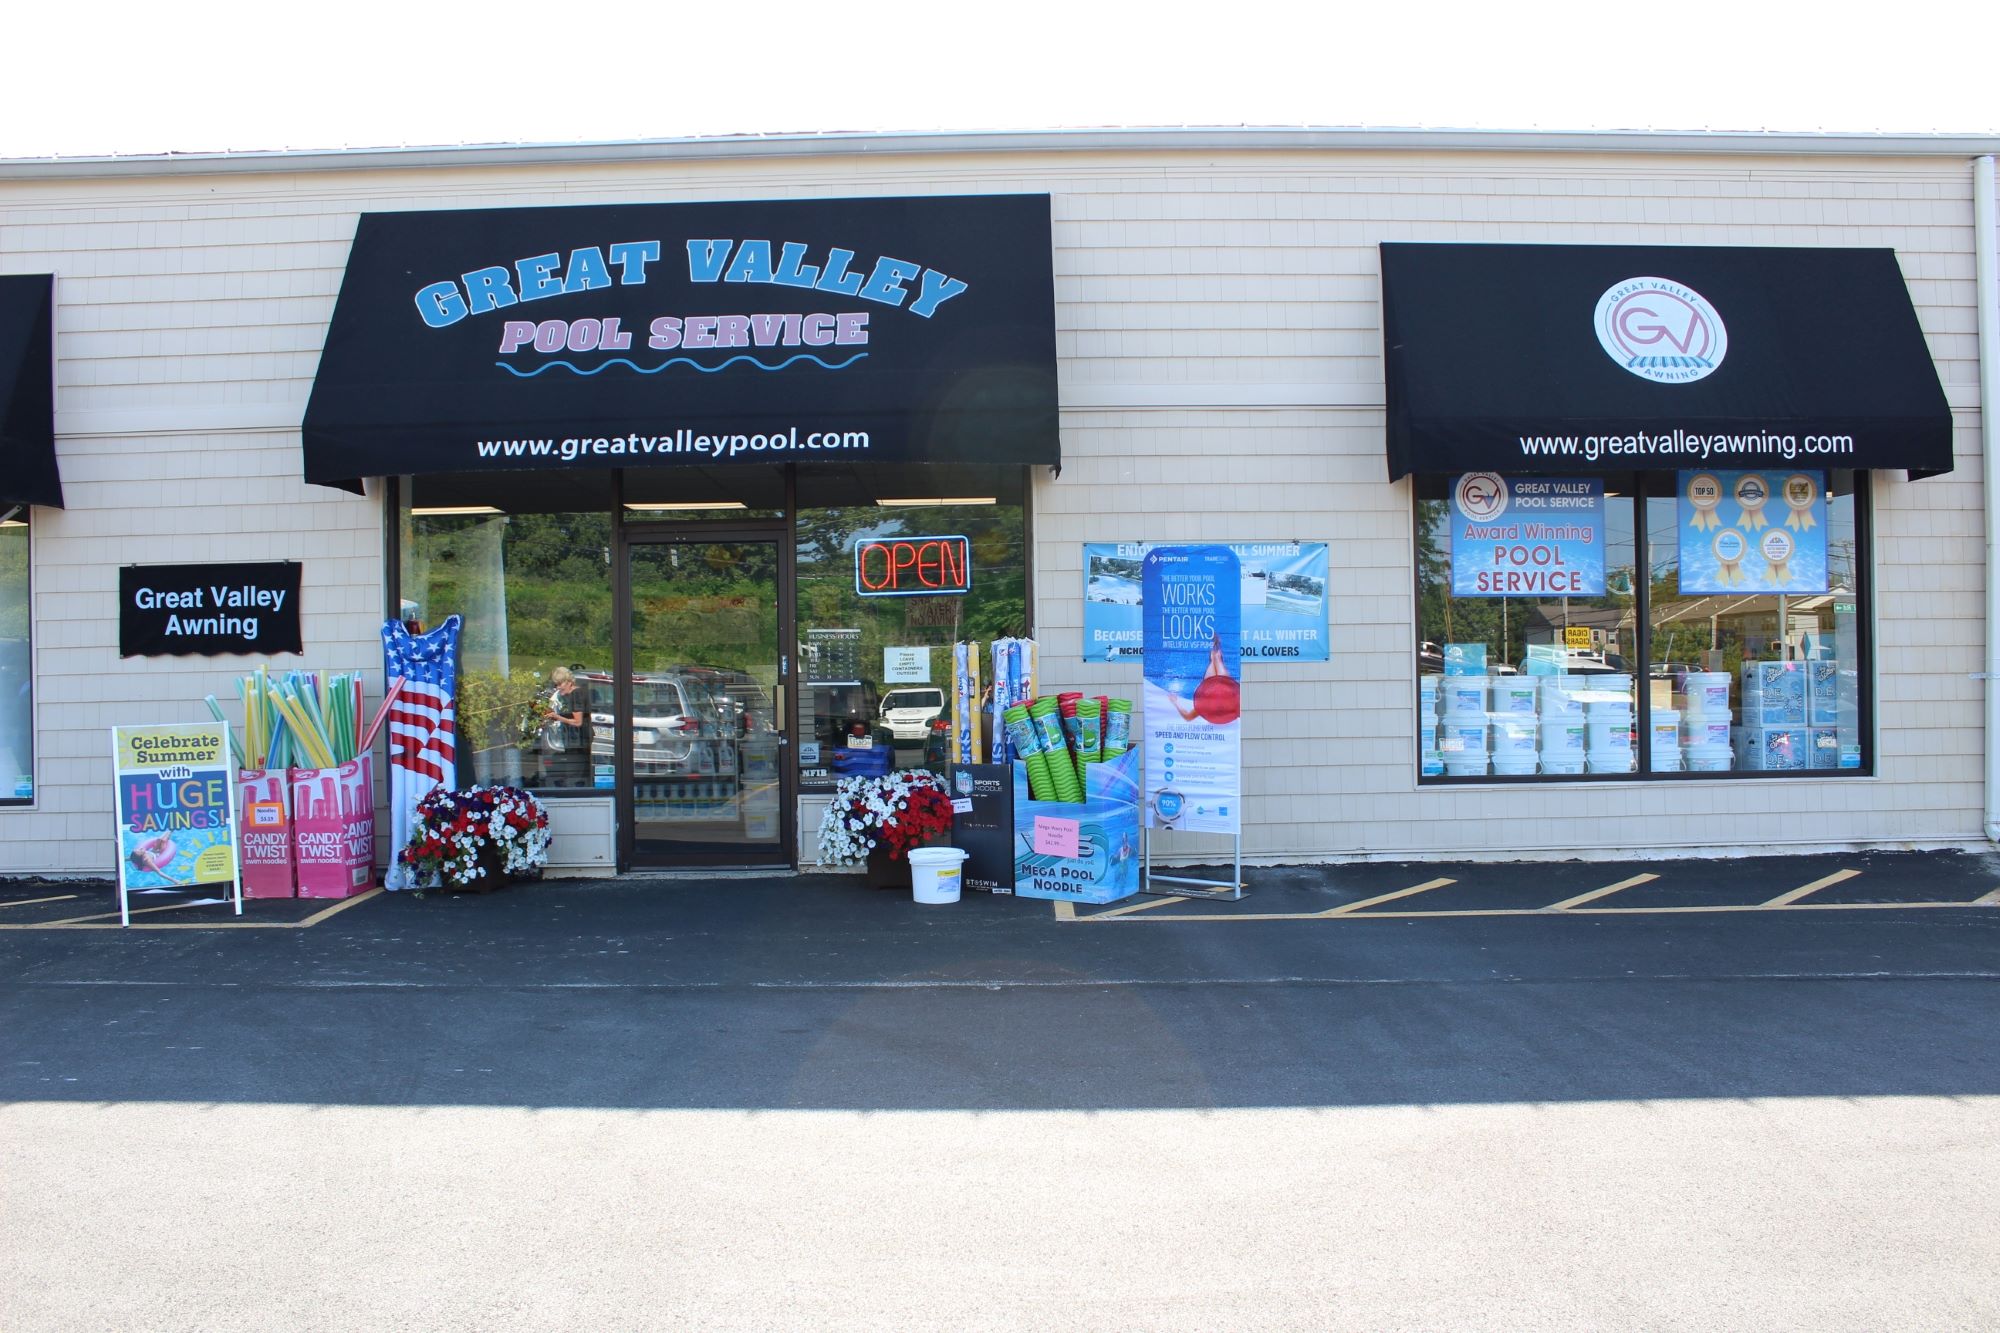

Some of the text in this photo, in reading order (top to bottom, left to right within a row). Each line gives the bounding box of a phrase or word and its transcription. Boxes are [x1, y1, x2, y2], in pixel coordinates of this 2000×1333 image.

[415, 239, 968, 328] GREAT VALLEY
[1611, 282, 1697, 303] GREAT VALLEY
[499, 312, 869, 353] POOL SERVICE
[1644, 368, 1699, 380] AWNING
[476, 427, 870, 461] www.greatvalleypool.com
[1520, 429, 1854, 460] www.greatvalleyawning.com
[1515, 483, 1591, 494] GREAT VALLEY
[1695, 487, 1706, 495] TOP
[1515, 497, 1594, 508] POOL SERVICE
[1464, 523, 1593, 544] Award Winning
[1251, 544, 1300, 557] SUMMER
[1494, 545, 1565, 566] POOL
[861, 541, 965, 590] OPEN
[1477, 571, 1581, 592] SERVICE
[135, 586, 286, 613] Great Valley
[1161, 583, 1215, 606] WORKS
[164, 614, 258, 640] Awning
[1162, 614, 1215, 640] LOOKS
[1094, 629, 1143, 642] BECAUSE
[1253, 630, 1271, 641] ALL
[1275, 630, 1318, 641] WINTER
[1262, 645, 1299, 657] COVERS
[131, 734, 220, 750] Celebrate
[1155, 731, 1172, 739] SPEED
[1201, 733, 1226, 741] CONTROL
[136, 750, 216, 763] Summer
[160, 766, 191, 779] with
[802, 768, 827, 777] NFIB
[131, 779, 224, 811] HUGE
[131, 809, 225, 832] SAVINGS!
[244, 833, 287, 845] CANDY
[299, 832, 341, 845] CANDY
[244, 845, 288, 858] TWIST
[299, 845, 343, 858] TWIST
[1021, 863, 1094, 880] MEGA POOL
[1033, 878, 1083, 893] NOODLE
